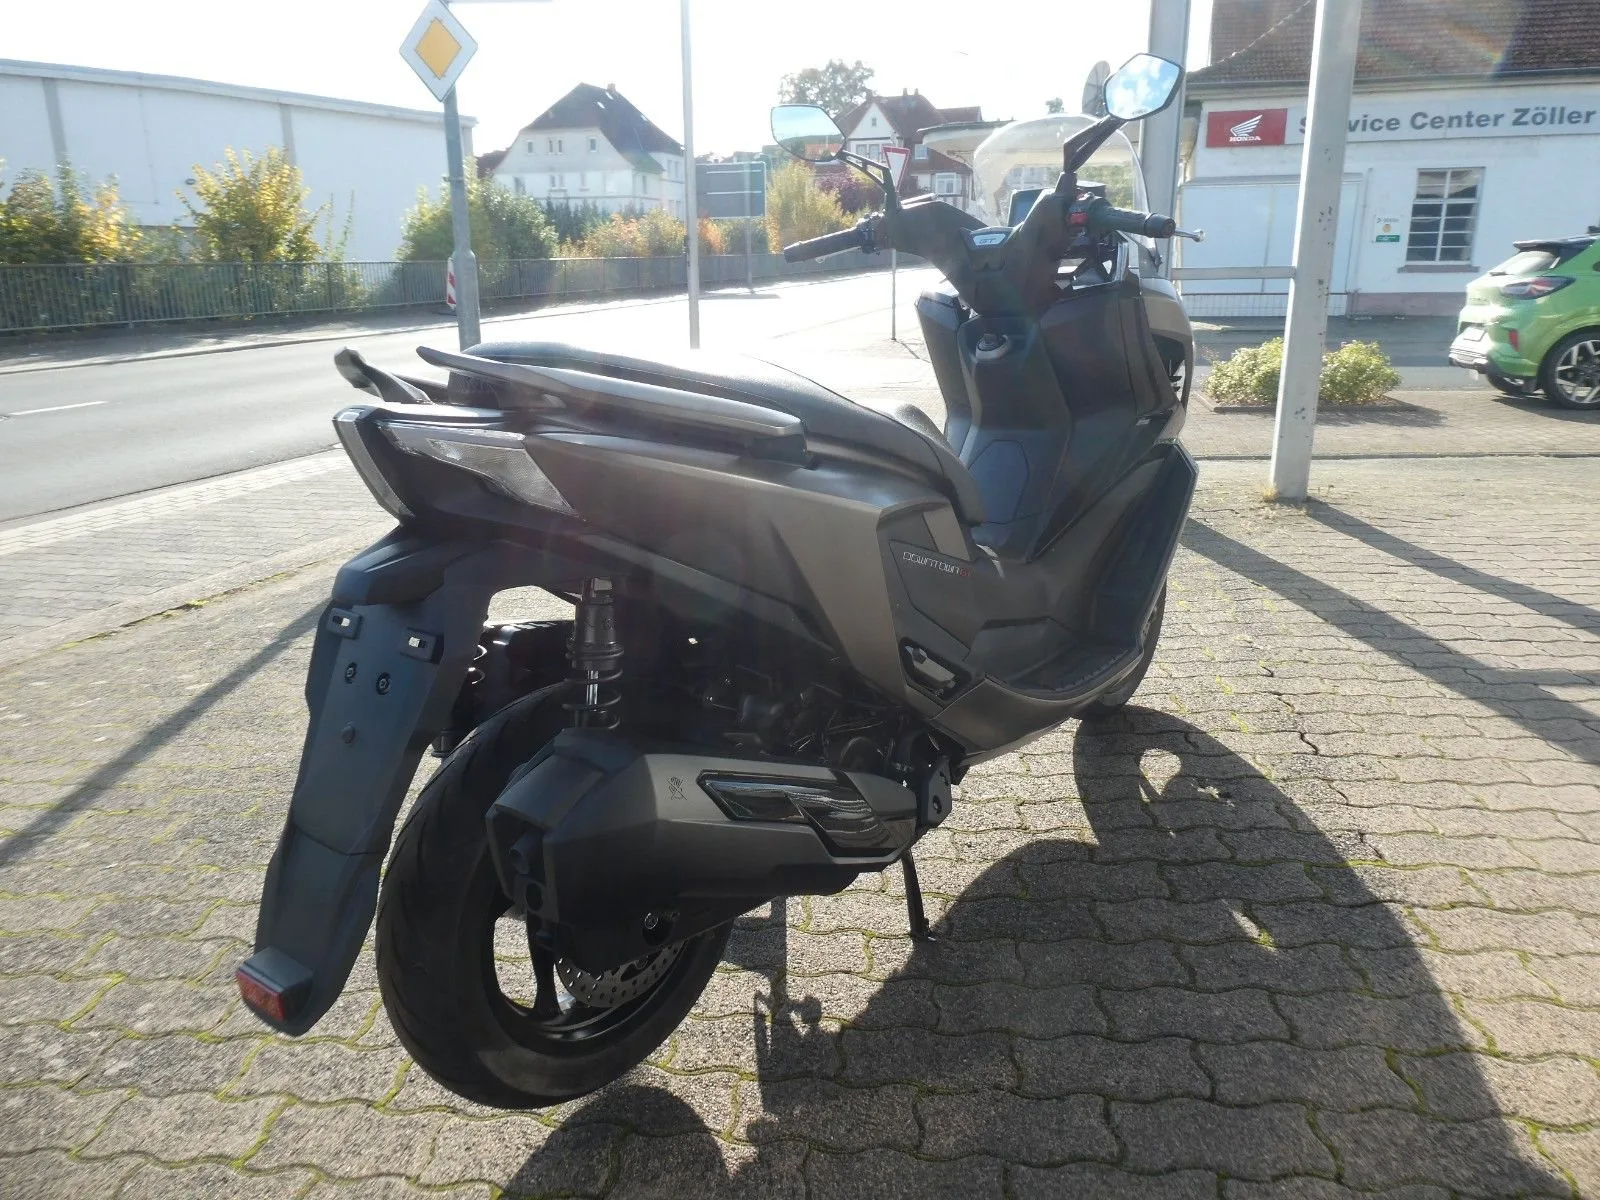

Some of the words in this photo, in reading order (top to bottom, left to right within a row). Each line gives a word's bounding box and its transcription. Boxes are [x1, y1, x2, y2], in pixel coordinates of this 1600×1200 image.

[1298, 114, 1400, 134] Svice
[1409, 111, 1504, 130] Center
[1512, 106, 1596, 126] Zöller
[1229, 134, 1262, 142] HONDA
